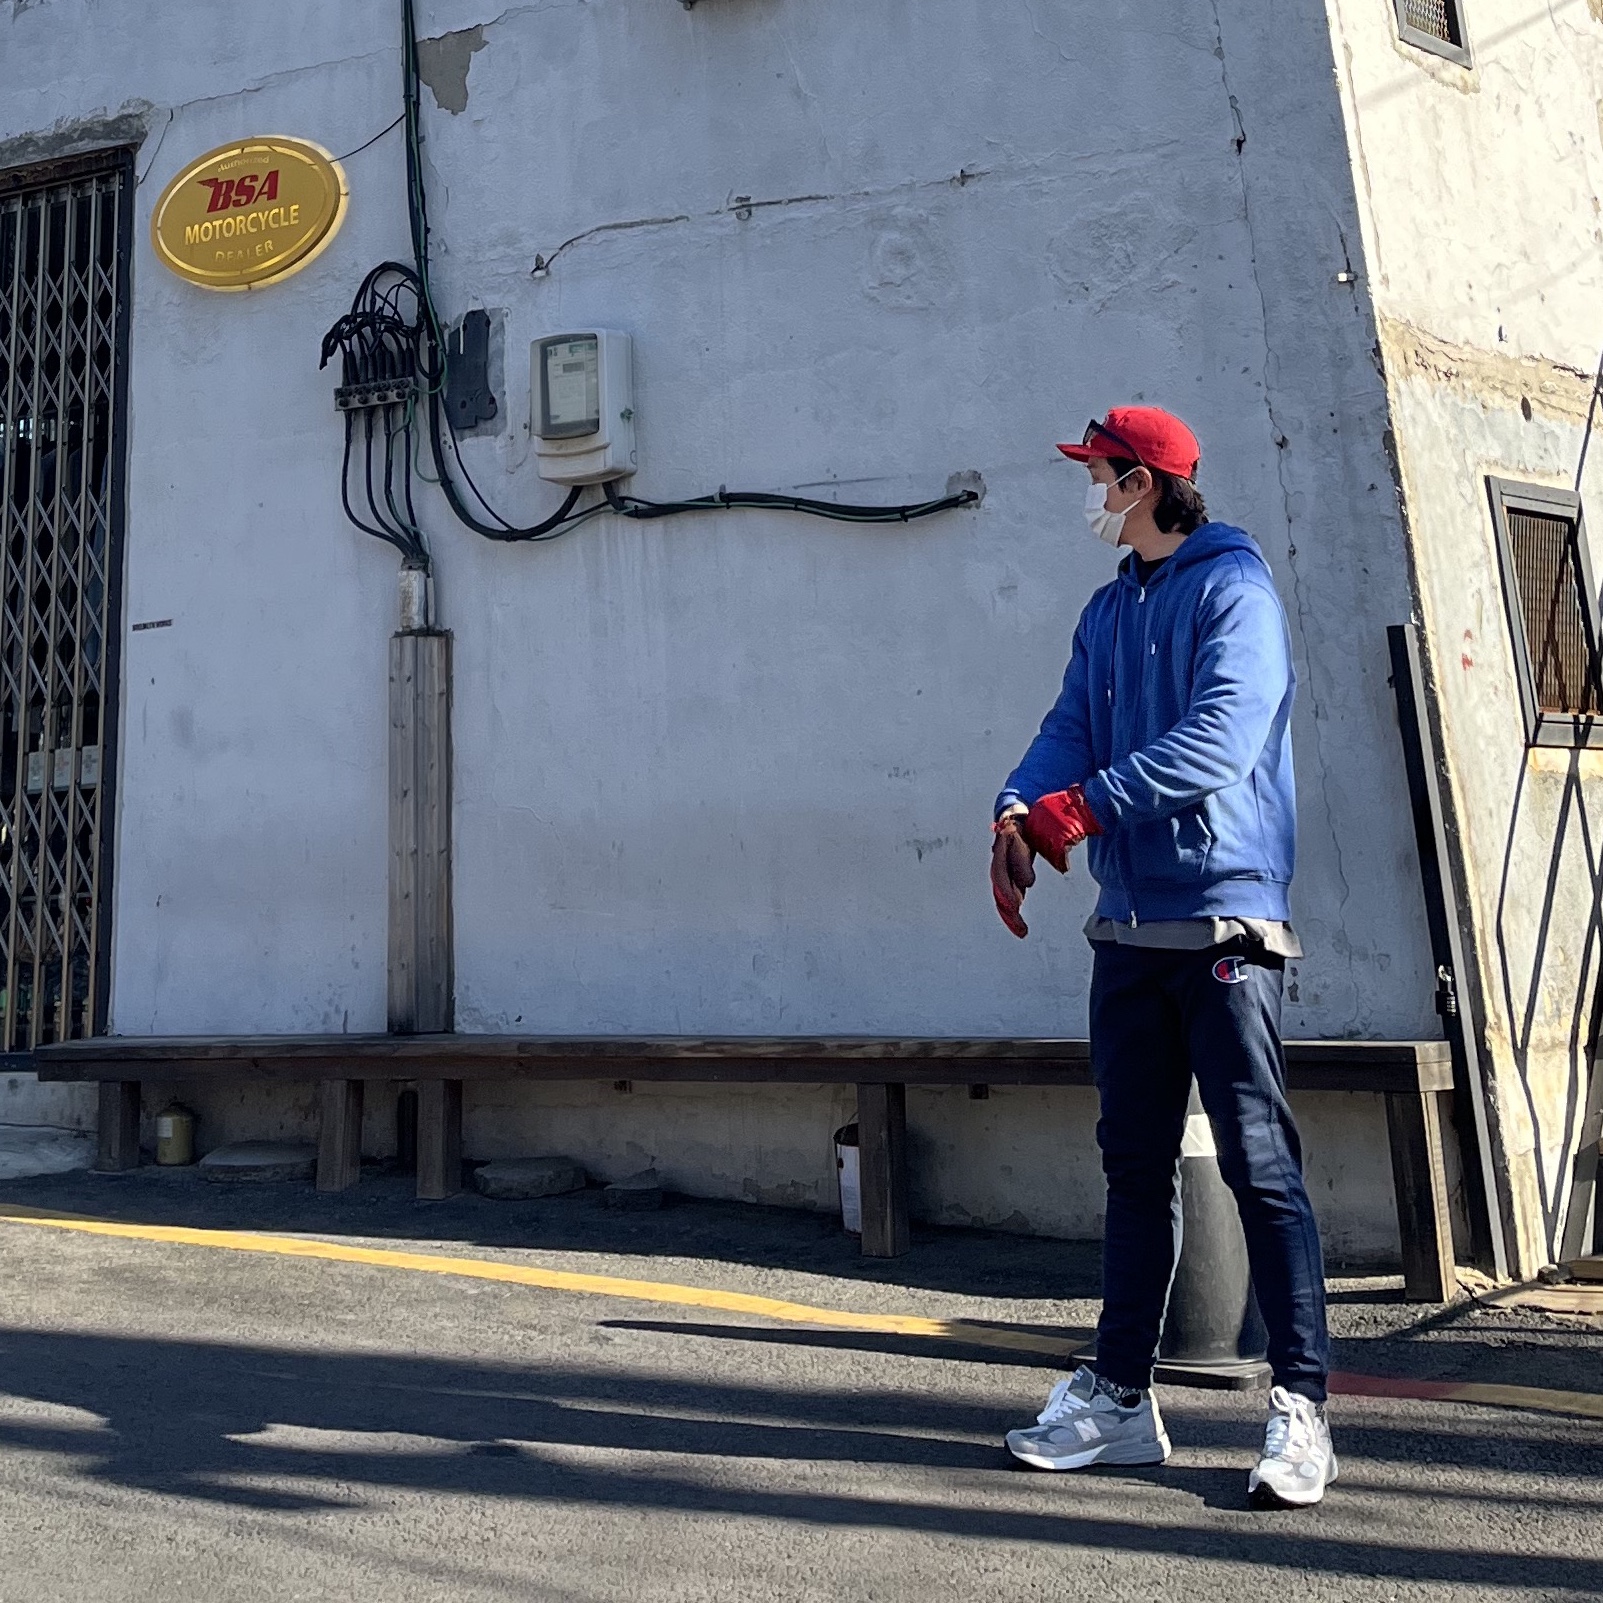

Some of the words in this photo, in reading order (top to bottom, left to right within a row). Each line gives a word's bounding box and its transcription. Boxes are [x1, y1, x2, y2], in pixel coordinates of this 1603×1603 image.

[197, 169, 280, 213] BSA
[184, 204, 300, 246] MOTORCYCLE
[215, 239, 274, 263] DEALER
[1073, 1417, 1102, 1442] N
